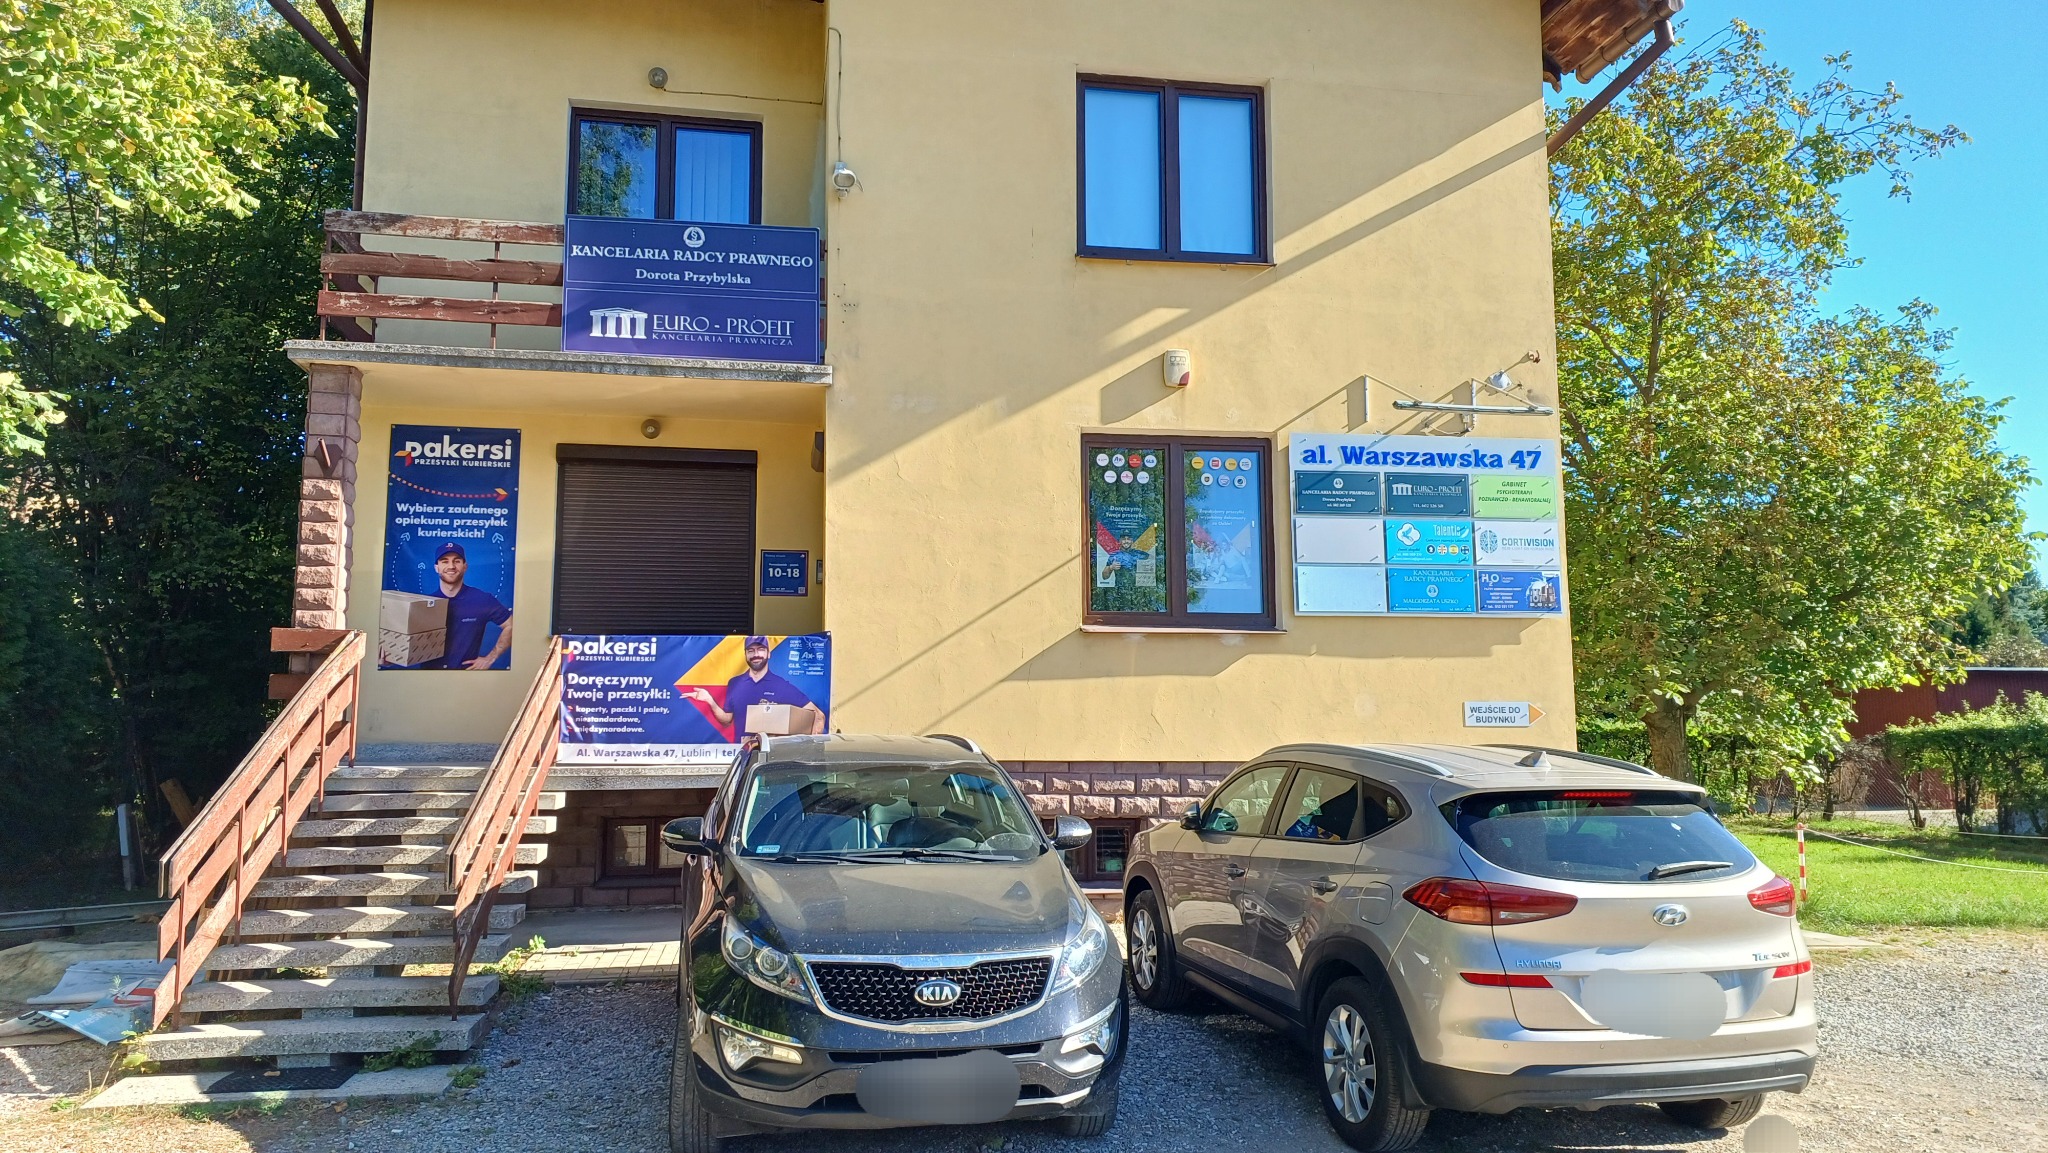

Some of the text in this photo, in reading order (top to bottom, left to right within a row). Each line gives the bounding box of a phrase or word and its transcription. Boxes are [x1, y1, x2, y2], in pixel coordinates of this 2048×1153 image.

[571, 245, 813, 267] KANCELARIA RADCY PRAWNEGO
[635, 268, 751, 286] Dorota Przybylska
[653, 314, 710, 332] EURO
[727, 318, 795, 336] PROFIT
[652, 333, 794, 346] KANCELARIA PRAWNICZA
[405, 435, 512, 460] pakersi
[415, 458, 511, 468] PRZESYŁKI KURIERSKIE
[1302, 445, 1542, 469] al. Warszawska 47
[396, 502, 508, 517] Wybierz zaufanego
[395, 515, 508, 528] opiekuna przesyłek
[417, 527, 485, 538] kurierskich!
[1501, 538, 1555, 547] CORTIVISION
[768, 568, 800, 578] 10-18
[568, 635, 657, 655] pakersi
[567, 672, 653, 688] Doręczymy
[567, 688, 671, 702] Twoje przesyłki:
[575, 705, 608, 714] koperty,
[611, 705, 637, 714] paczki
[643, 706, 670, 714] palety,
[1469, 704, 1521, 714] WEJŚCIE DO
[575, 716, 641, 724] niestandardowe,
[1475, 715, 1516, 723] BUDYNKU
[576, 748, 590, 757] Al.
[593, 748, 660, 757] Warszawska
[663, 749, 678, 759] 47,
[681, 749, 711, 757] Lublin
[922, 986, 952, 1001] KIA
